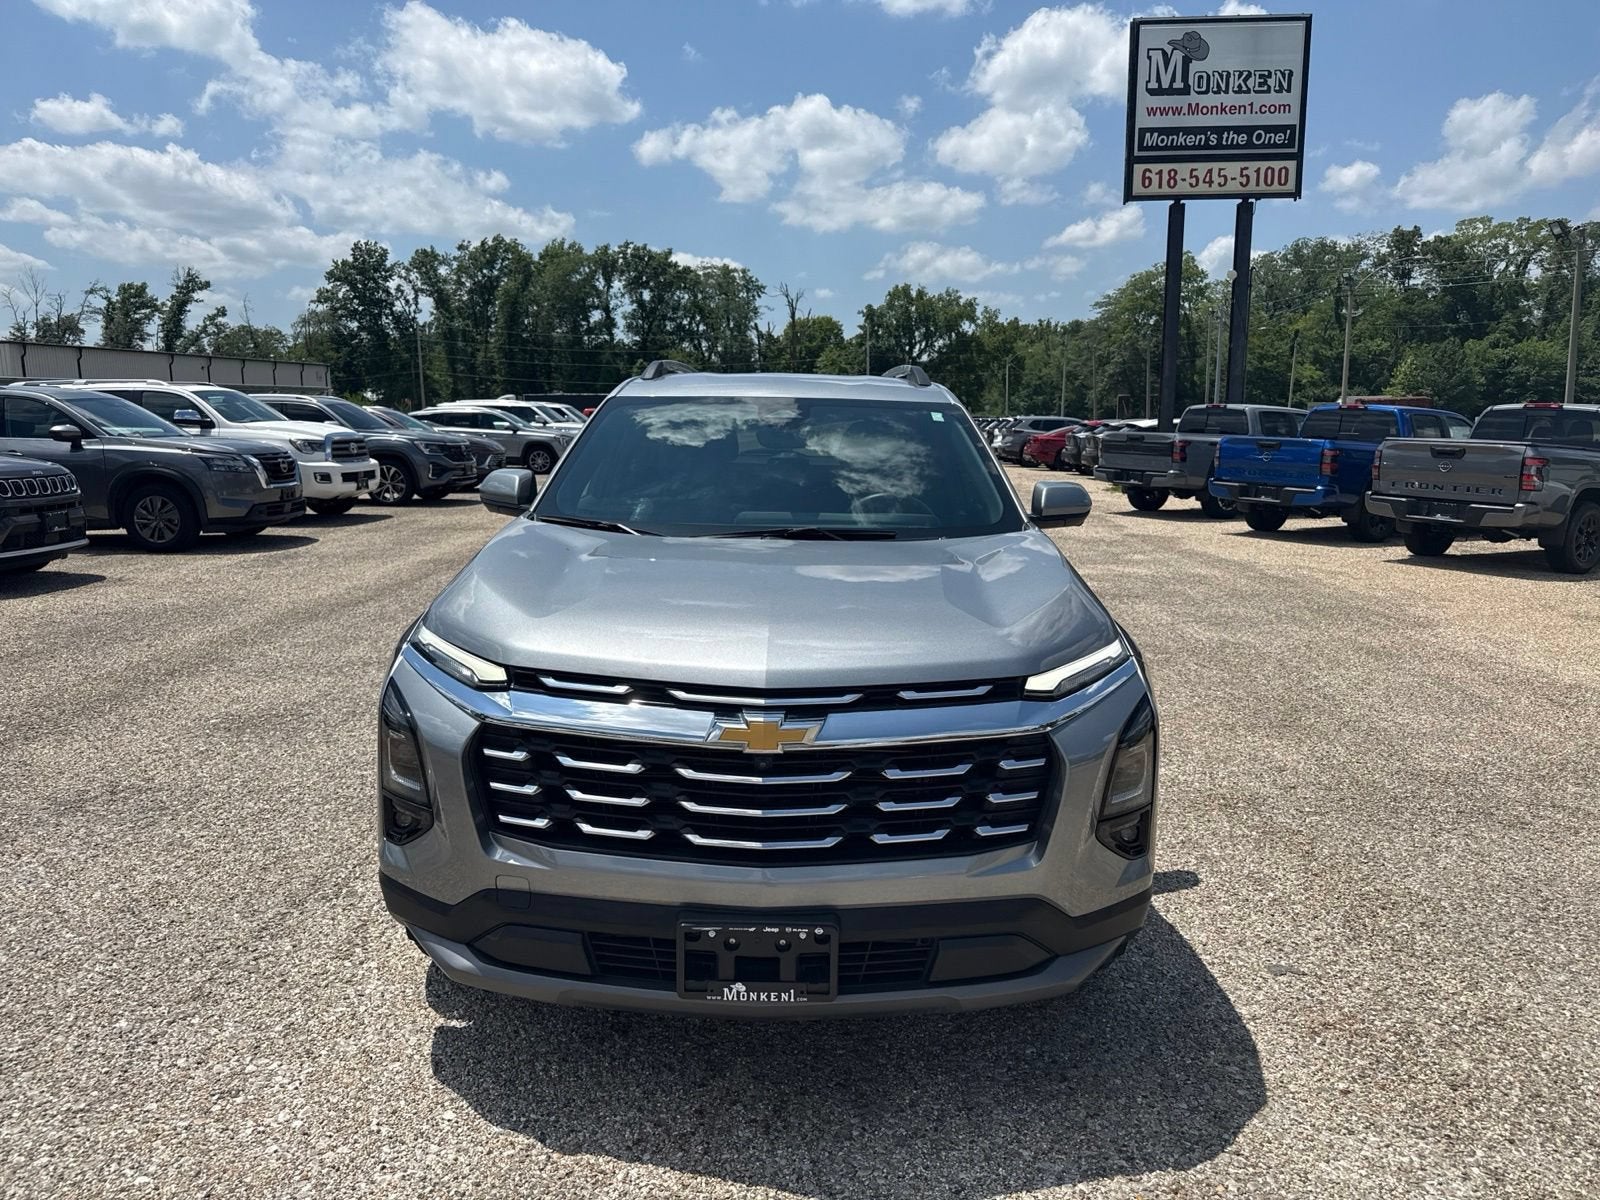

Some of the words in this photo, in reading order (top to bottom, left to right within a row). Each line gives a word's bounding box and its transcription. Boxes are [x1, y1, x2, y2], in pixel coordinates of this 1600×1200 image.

[1146, 102, 1292, 117] www.Monken1.com
[1143, 131, 1218, 147] Monken's
[1222, 130, 1248, 145] the
[1252, 129, 1291, 145] One!
[1141, 166, 1290, 189] 618-545-5100
[1391, 481, 1504, 496] FRONTIER
